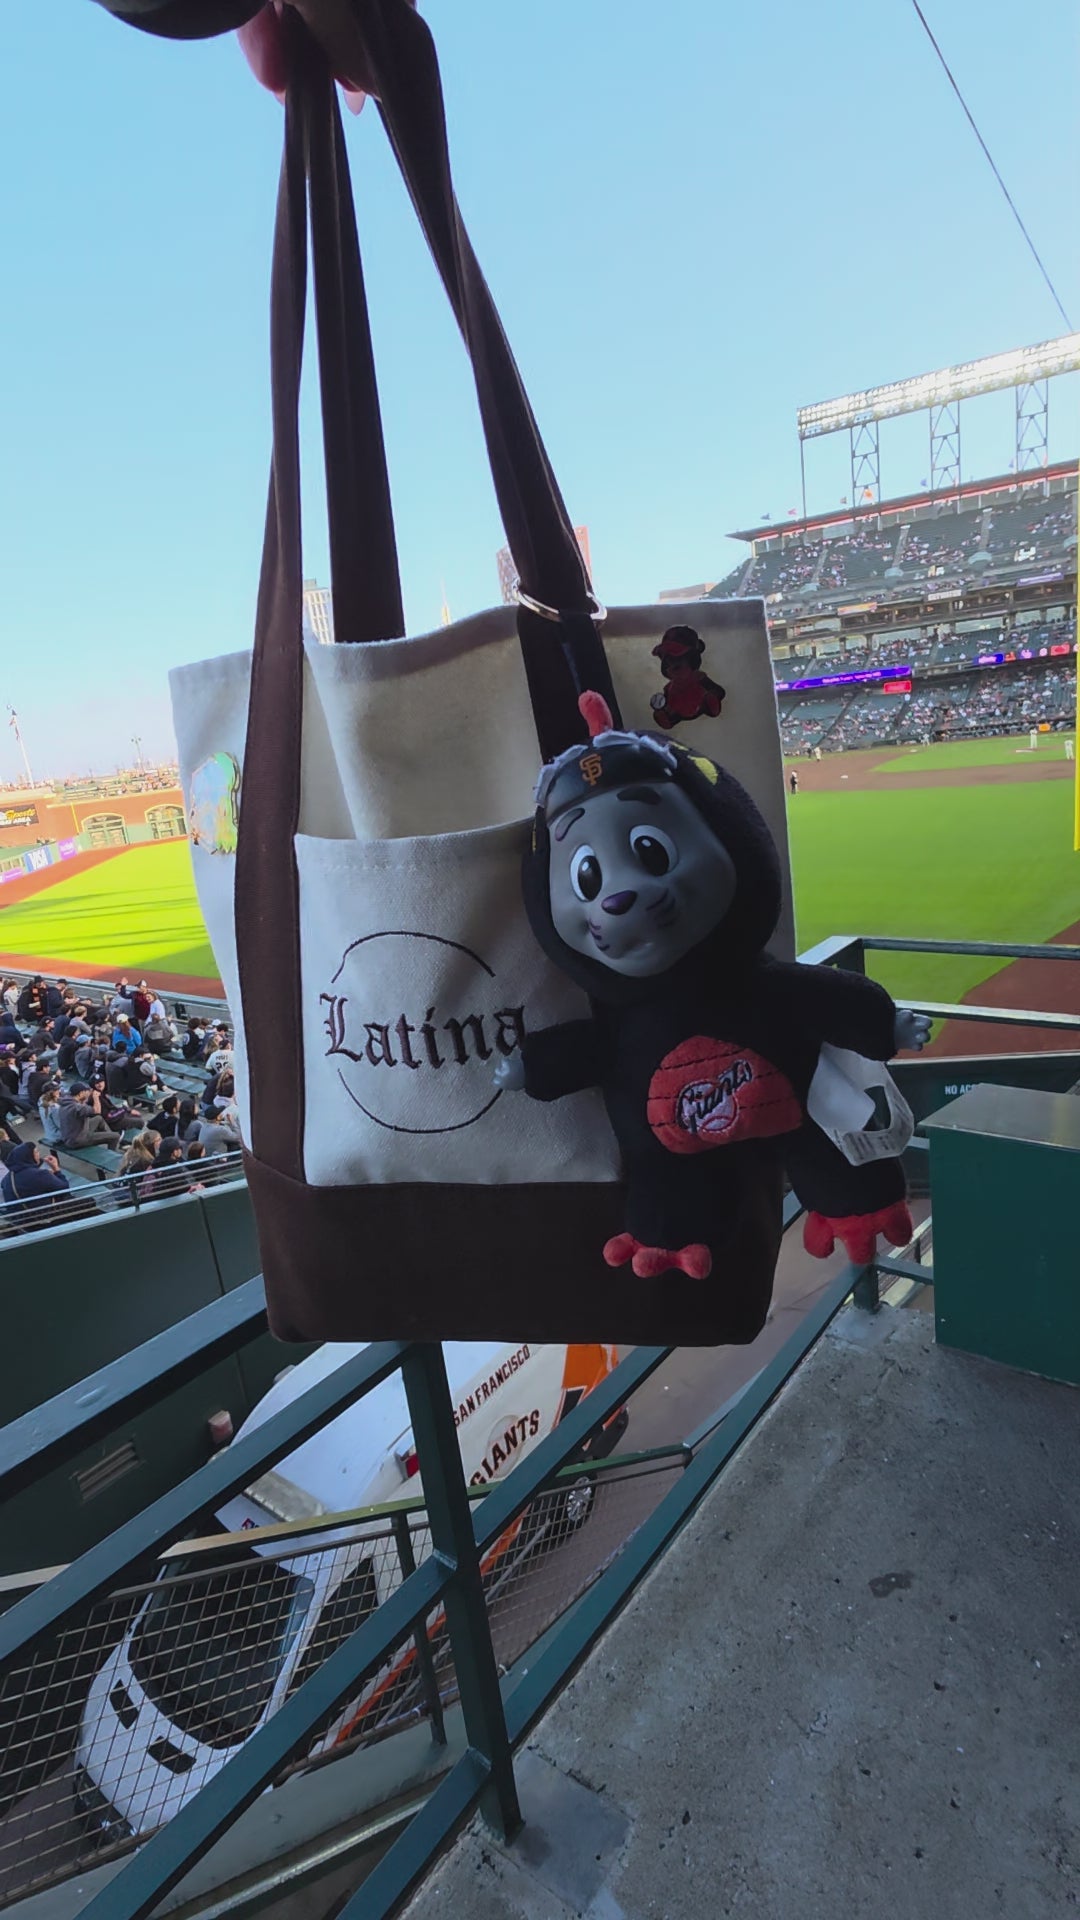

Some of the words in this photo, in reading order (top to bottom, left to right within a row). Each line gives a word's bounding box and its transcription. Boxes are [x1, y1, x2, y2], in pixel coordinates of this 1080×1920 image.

[580, 753, 602, 786] SF
[944, 1085, 958, 1095] NO
[453, 1395, 476, 1427] SAN
[474, 1343, 531, 1406] FRANCISCO
[469, 1408, 540, 1486] GIANTS
